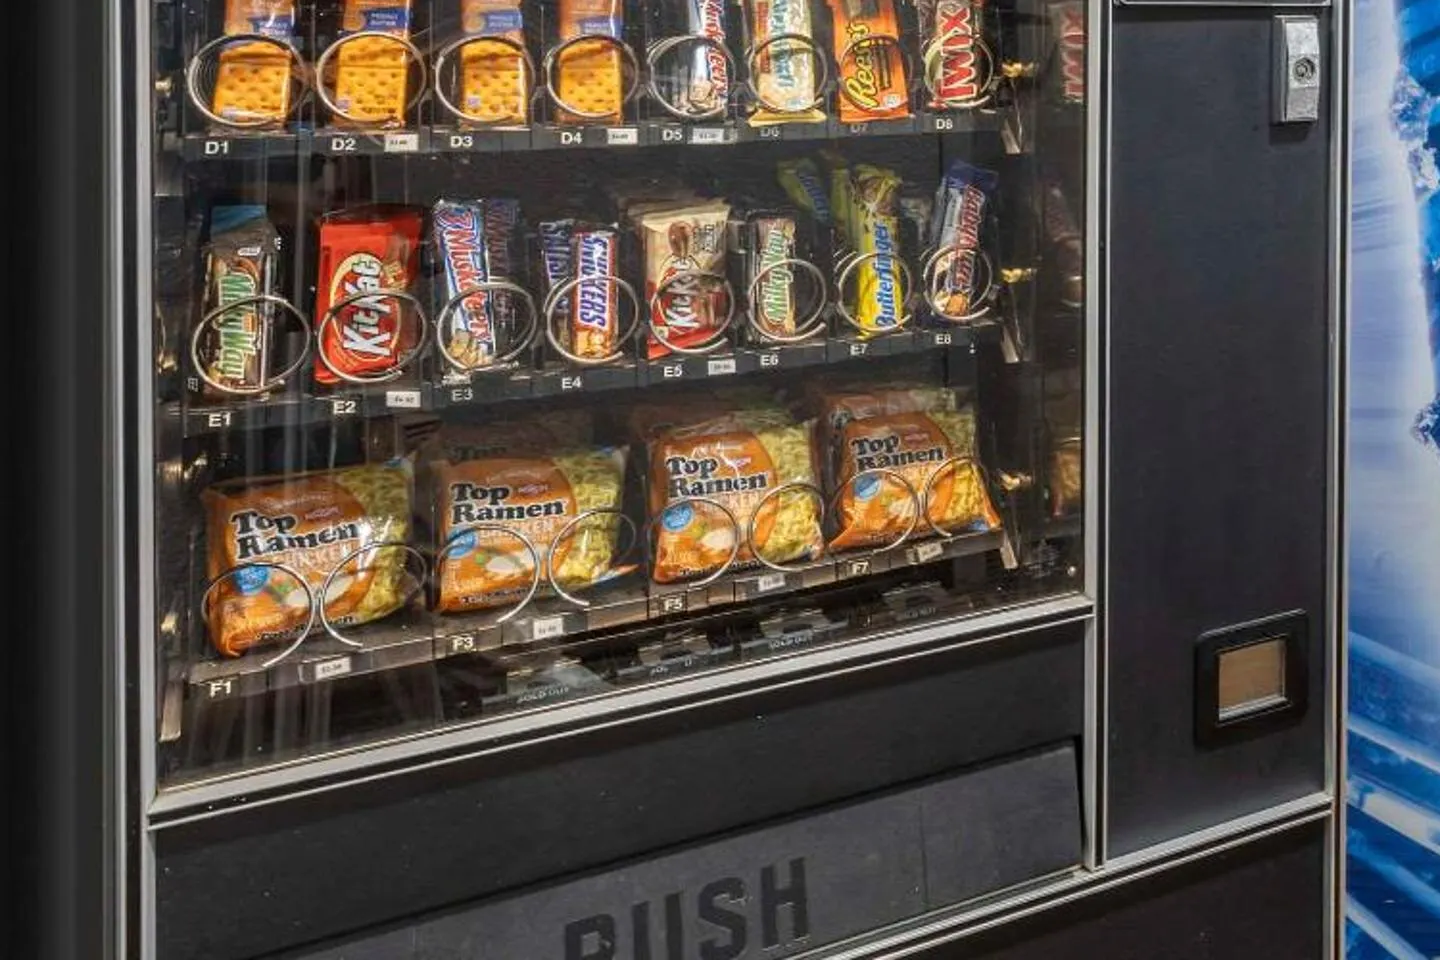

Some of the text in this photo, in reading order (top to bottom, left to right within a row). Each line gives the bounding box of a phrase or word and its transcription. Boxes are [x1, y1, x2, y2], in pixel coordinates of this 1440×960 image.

[942, 6, 978, 99] TWIX
[936, 119, 953, 129] D8
[561, 132, 583, 145] D4
[662, 129, 682, 141] D5
[760, 126, 780, 139] D6
[205, 141, 229, 155] D1
[332, 137, 356, 152] D2
[450, 135, 473, 149] D3
[874, 223, 895, 327] Butterfinger
[935, 333, 952, 345] E8
[851, 344, 869, 356] E7
[760, 354, 779, 366] E6
[663, 365, 683, 378] E5
[561, 377, 582, 389] E4
[452, 388, 473, 401] E3
[333, 401, 356, 414] E2
[208, 412, 231, 427] E1
[851, 434, 900, 456] Top
[856, 447, 945, 471] Ramen
[665, 455, 718, 479] Top
[668, 473, 768, 498] Ramen
[451, 482, 510, 506] Top
[453, 500, 565, 525] Ramen
[231, 510, 297, 535] Top
[236, 522, 364, 560] Ramen
[852, 562, 869, 574] F7
[665, 598, 683, 611] F5
[453, 637, 475, 651] F3
[210, 682, 232, 697] F1
